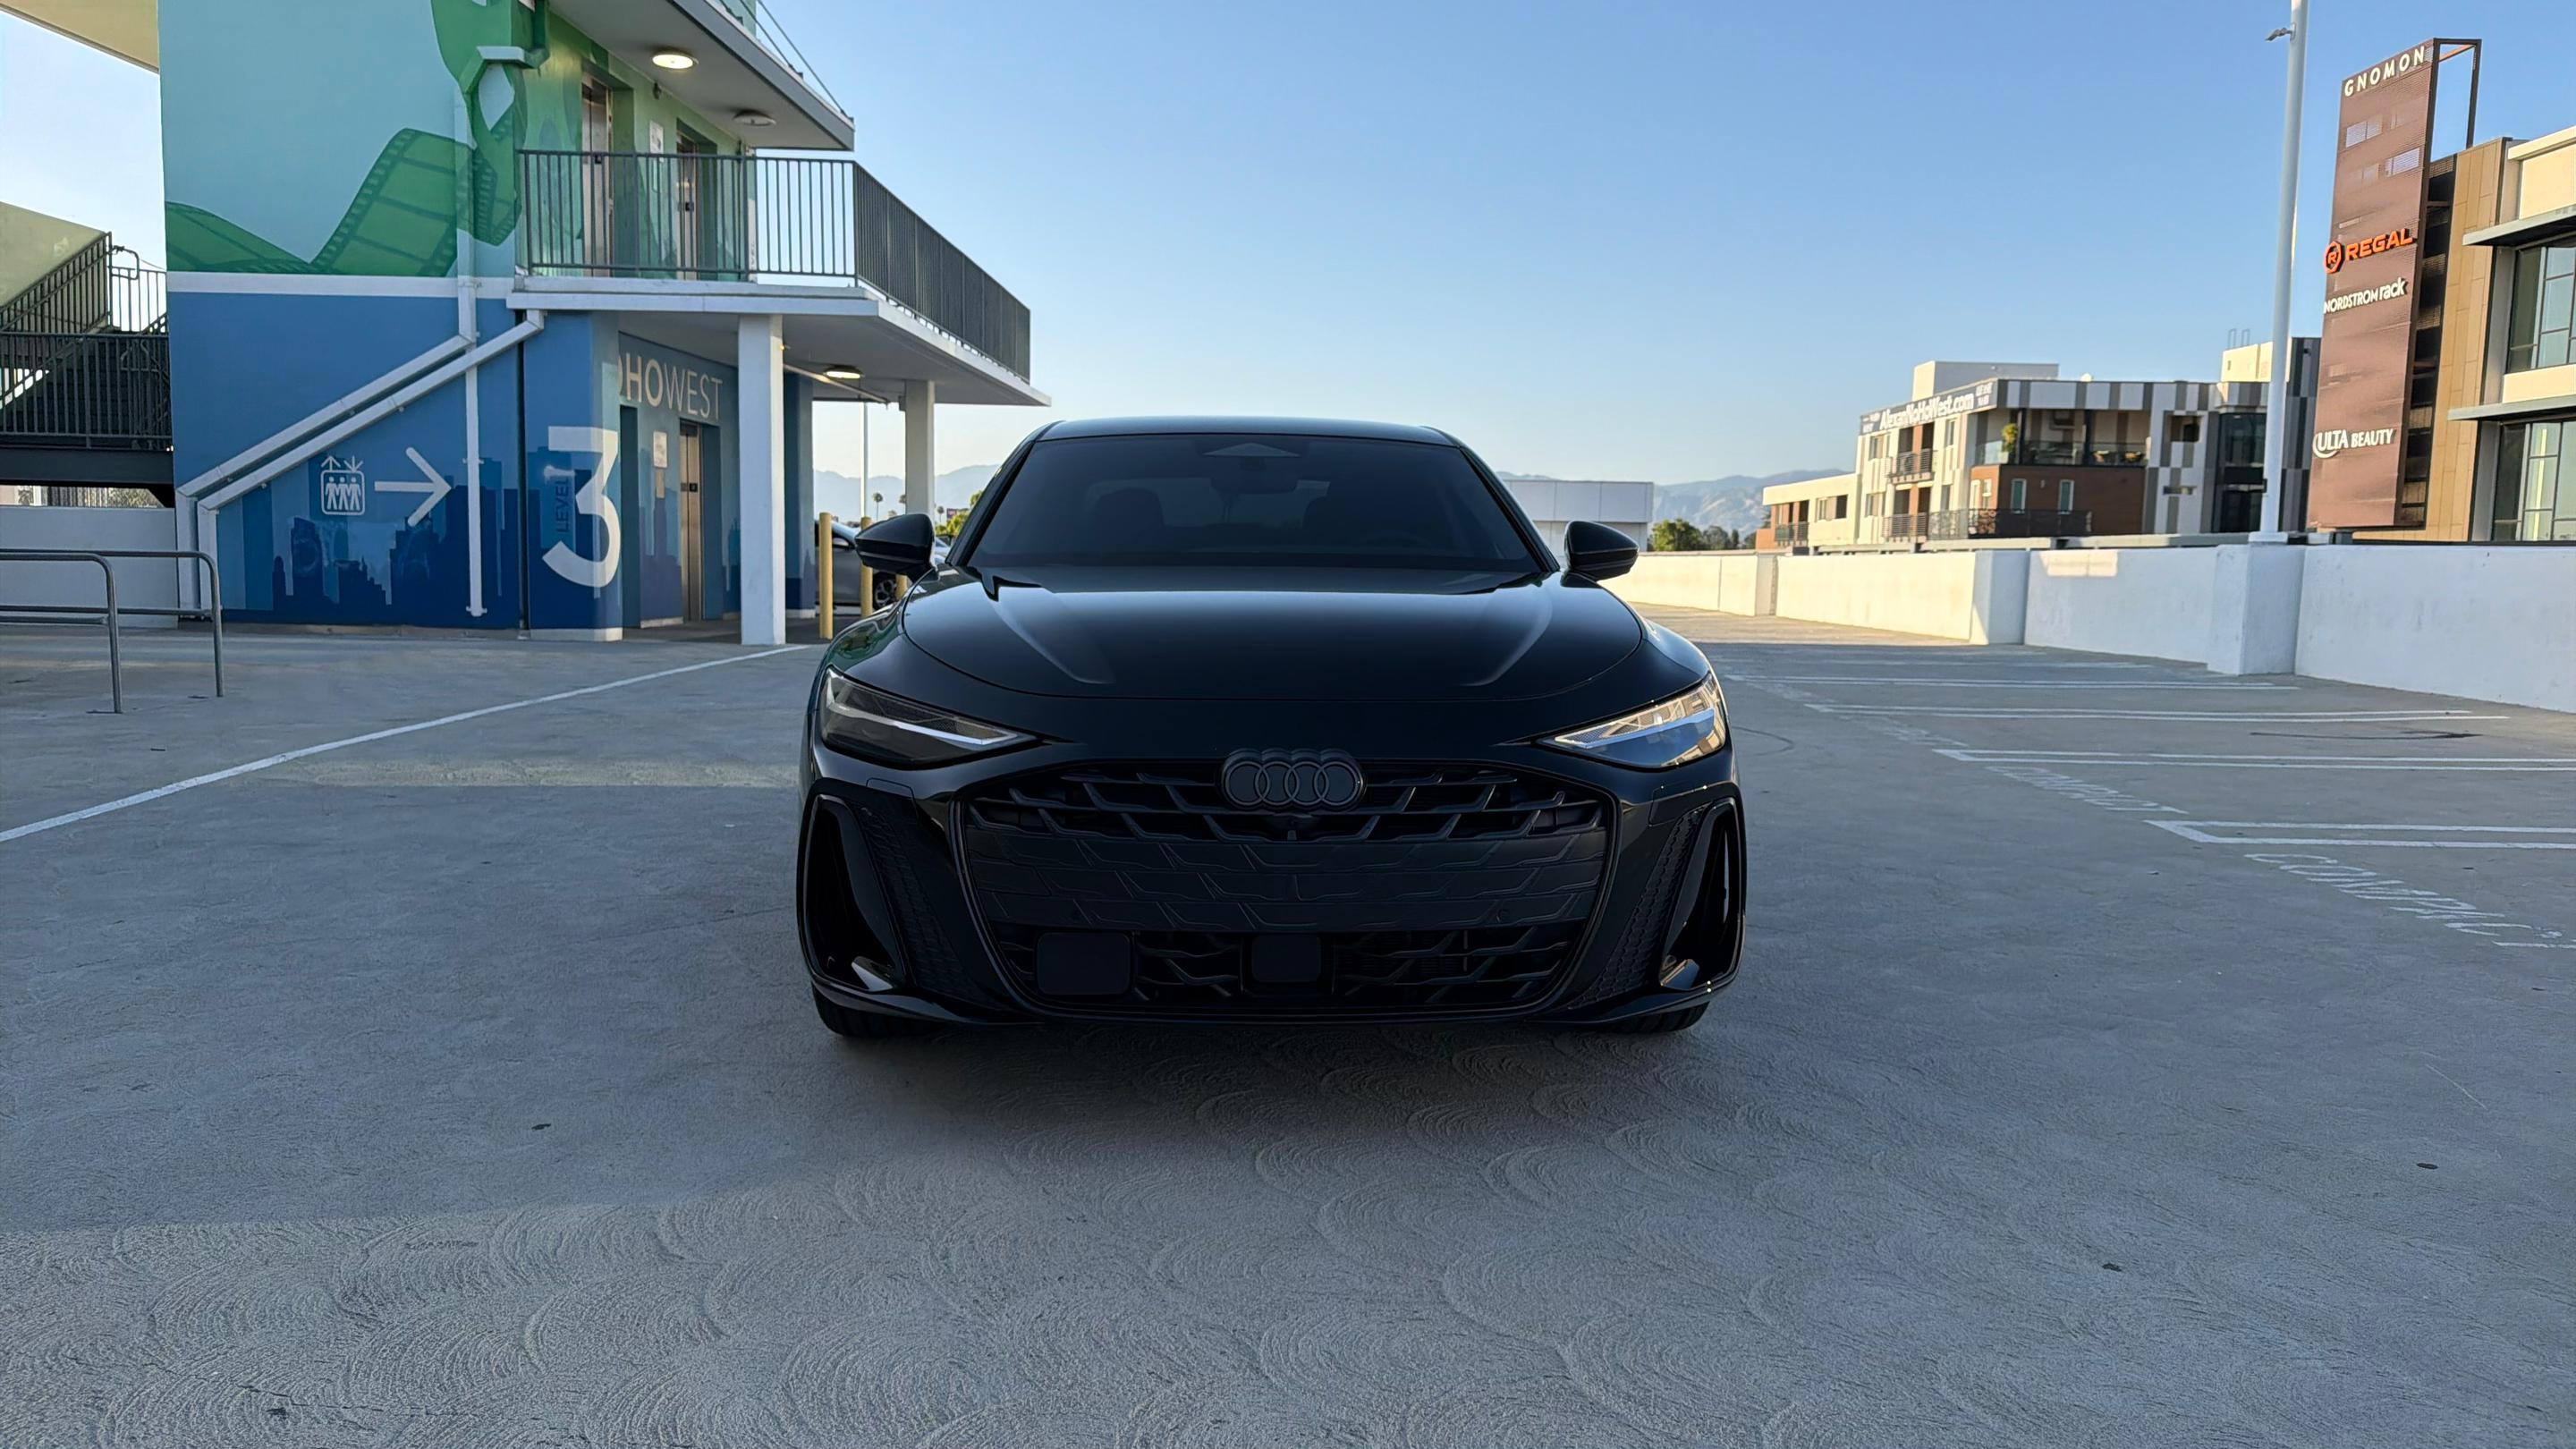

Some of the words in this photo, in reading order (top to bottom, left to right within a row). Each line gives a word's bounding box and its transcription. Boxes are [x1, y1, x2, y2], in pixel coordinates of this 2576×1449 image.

[2344, 46, 2425, 97] GNOMON
[2345, 228, 2413, 262] REGAL
[2323, 288, 2379, 314] NORDSTROM
[2379, 277, 2406, 300] rack
[617, 352, 723, 420] HOWEST
[2313, 429, 2349, 458] ULTA
[2351, 428, 2394, 448] BEAUTY
[542, 426, 621, 588] 3
[555, 477, 569, 533] LEVEL
